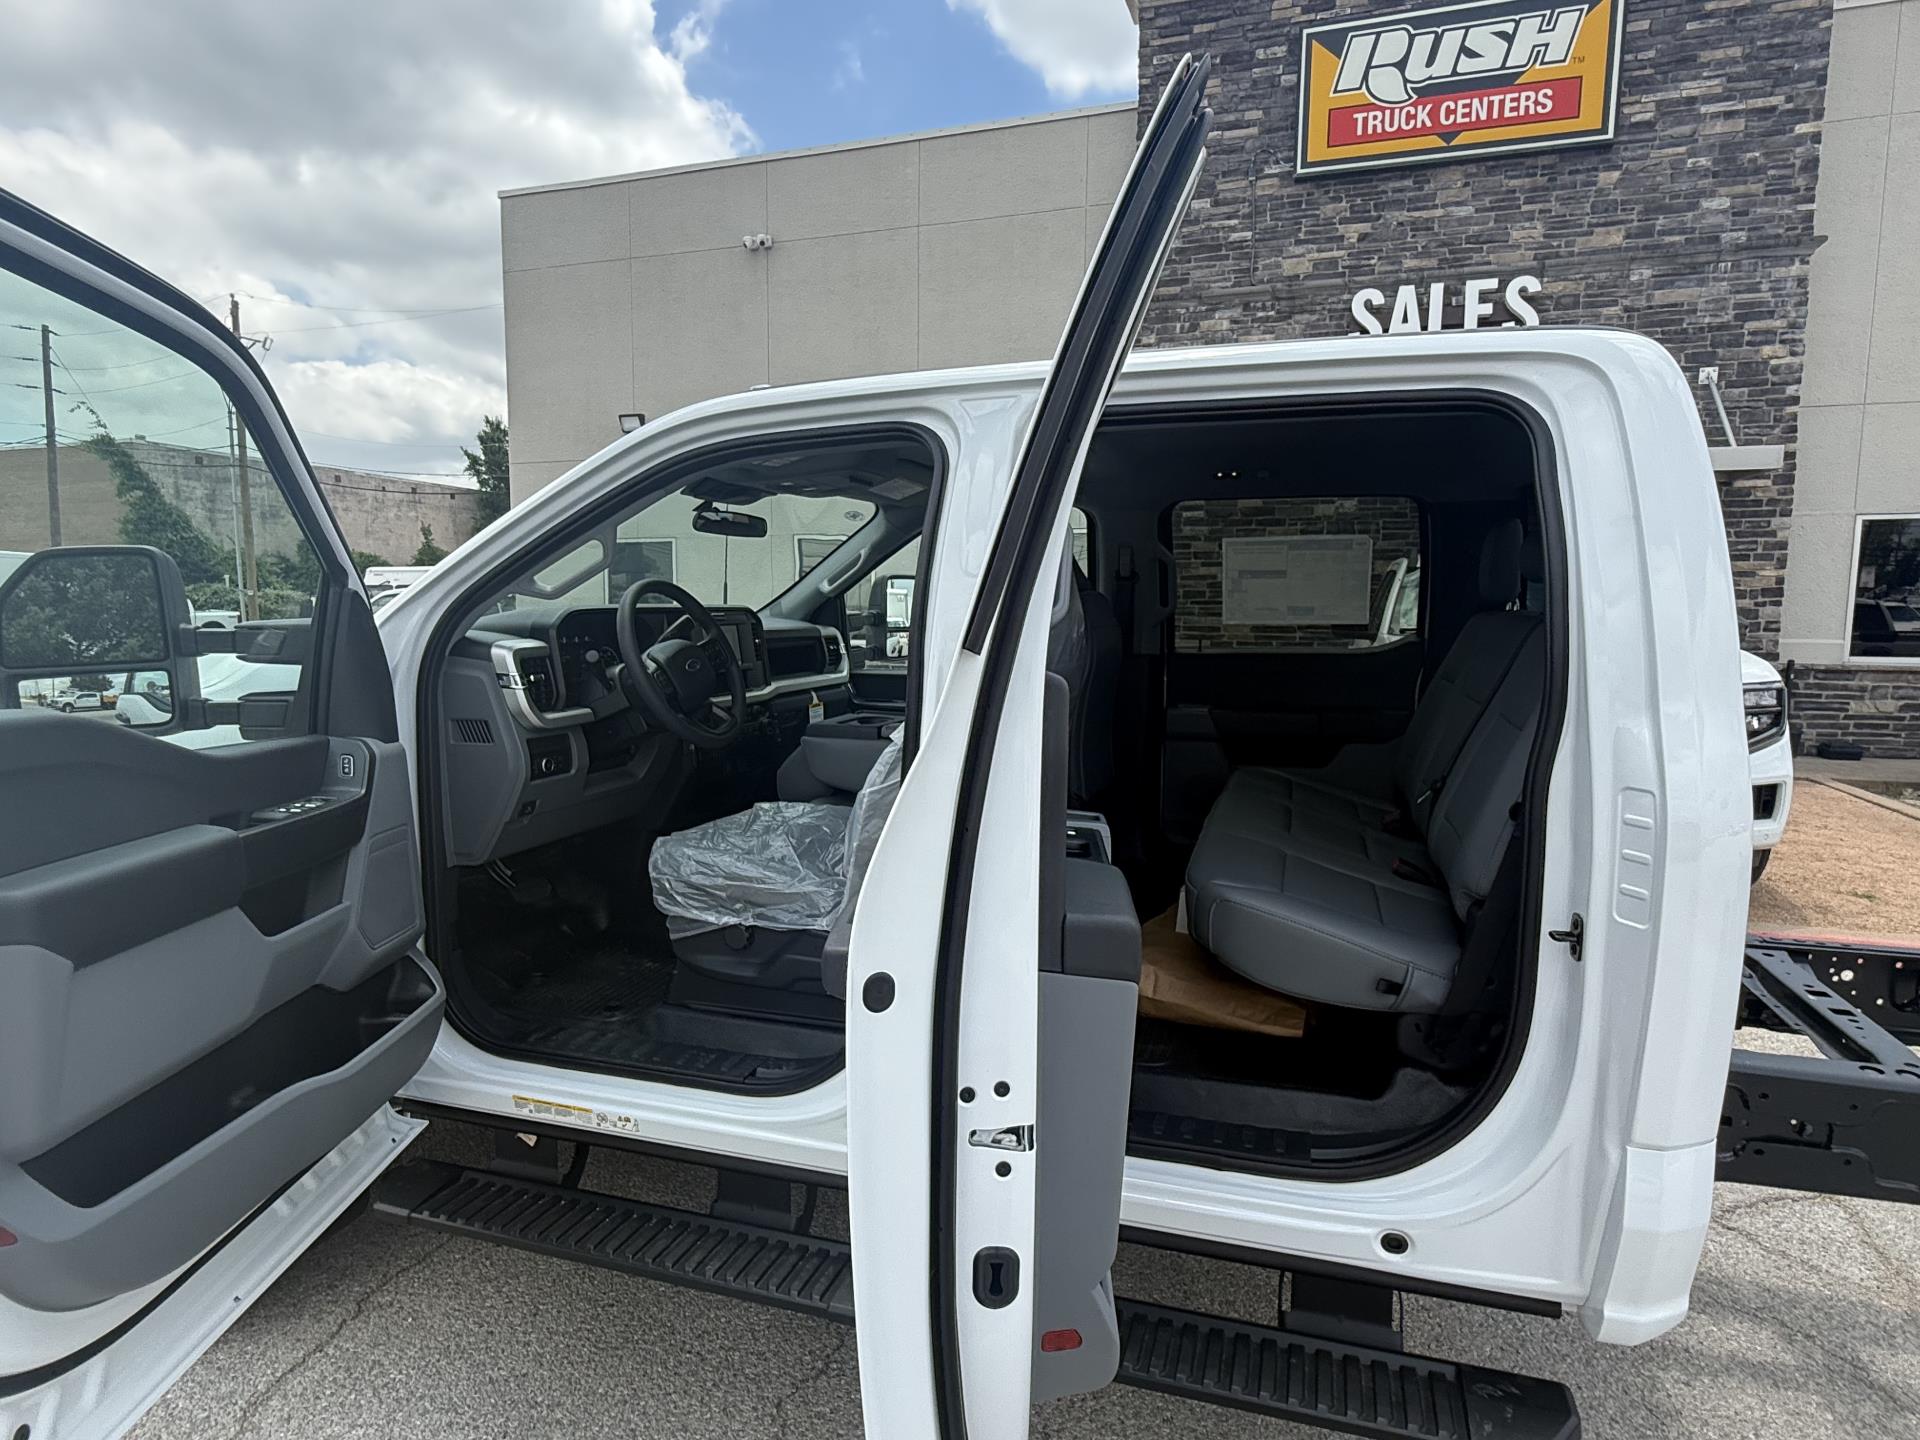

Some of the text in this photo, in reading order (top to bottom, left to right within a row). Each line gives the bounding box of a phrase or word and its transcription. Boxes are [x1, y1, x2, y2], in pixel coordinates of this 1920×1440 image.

[1331, 6, 1588, 106] RUSH
[1353, 88, 1553, 136] TRUCK CENTERS
[1348, 275, 1542, 337] SALES
